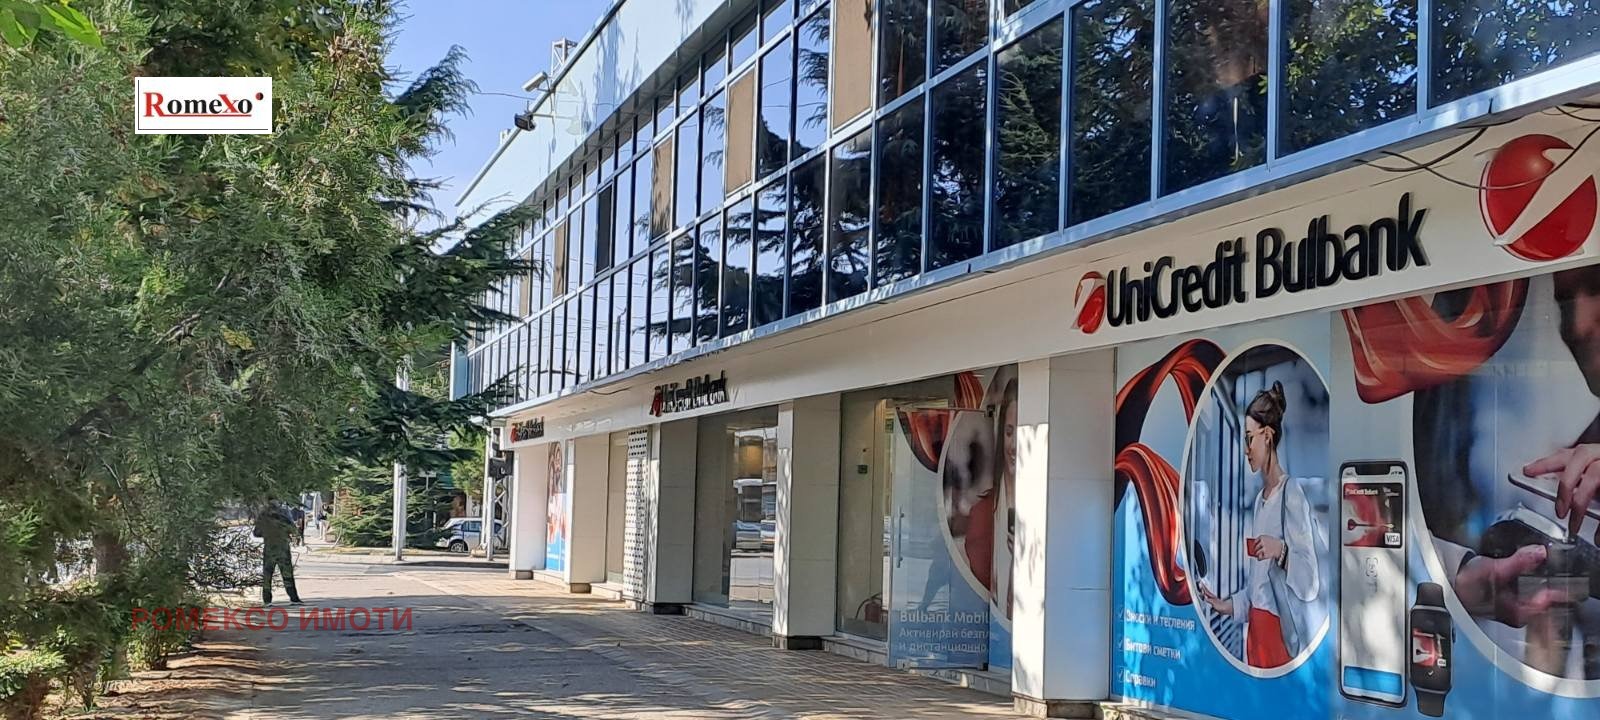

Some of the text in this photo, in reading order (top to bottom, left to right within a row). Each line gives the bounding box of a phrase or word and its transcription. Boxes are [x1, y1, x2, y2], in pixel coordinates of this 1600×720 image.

[1106, 191, 1431, 328] UniCredit Bulbank
[900, 609, 950, 623] Bulbank
